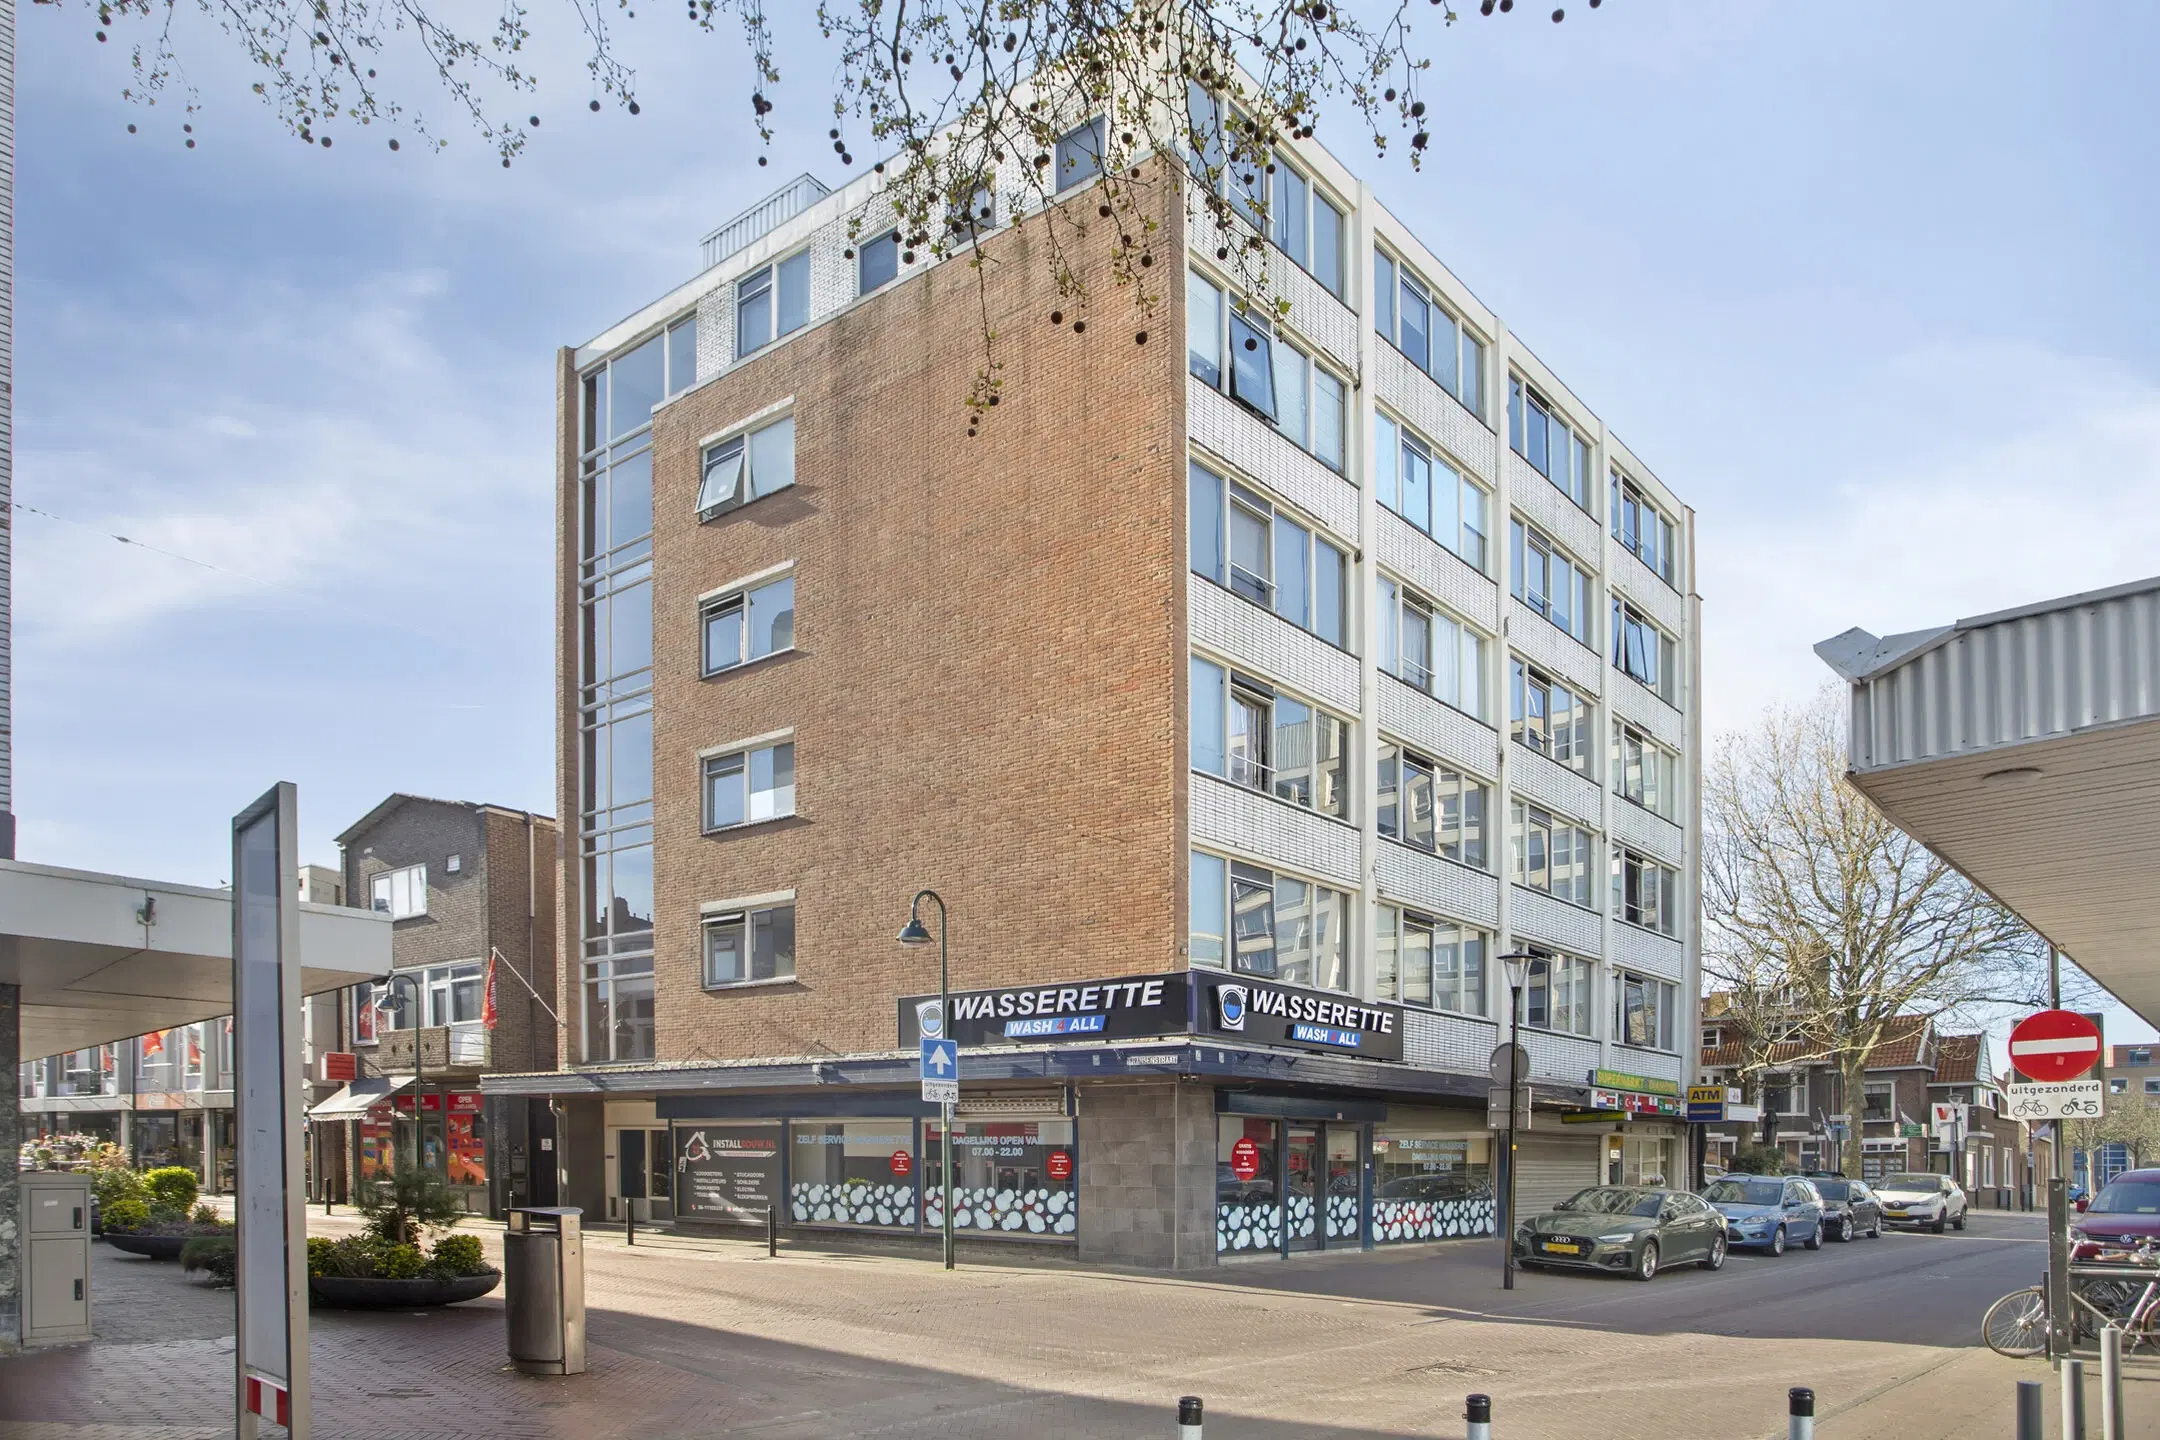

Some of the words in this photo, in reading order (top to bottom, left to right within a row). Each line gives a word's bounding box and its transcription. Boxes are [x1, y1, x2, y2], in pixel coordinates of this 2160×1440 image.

[953, 980, 1164, 1021] WASSERETTE
[1252, 988, 1394, 1034] WASSERETTE
[1009, 1020, 1052, 1035] WASH
[1056, 1019, 1065, 1033] 4
[1069, 1017, 1099, 1031] ALL
[1296, 1026, 1328, 1043] WASH
[1330, 1031, 1337, 1042] 4
[1338, 1032, 1357, 1046] ALL
[1597, 1070, 1644, 1089] SUPERMARKT
[1692, 1090, 1720, 1100] ATM
[2011, 1083, 2099, 1097] uitgezonderd
[713, 1139, 776, 1149] INSTALLBOUW.NL
[796, 1135, 816, 1144] ZELF
[819, 1135, 850, 1144] SERVICE
[1000, 1136, 1024, 1145] OPEN
[1399, 1140, 1413, 1149] ZELF
[972, 1148, 994, 1156] 07.00
[1000, 1147, 1024, 1156] 22.00
